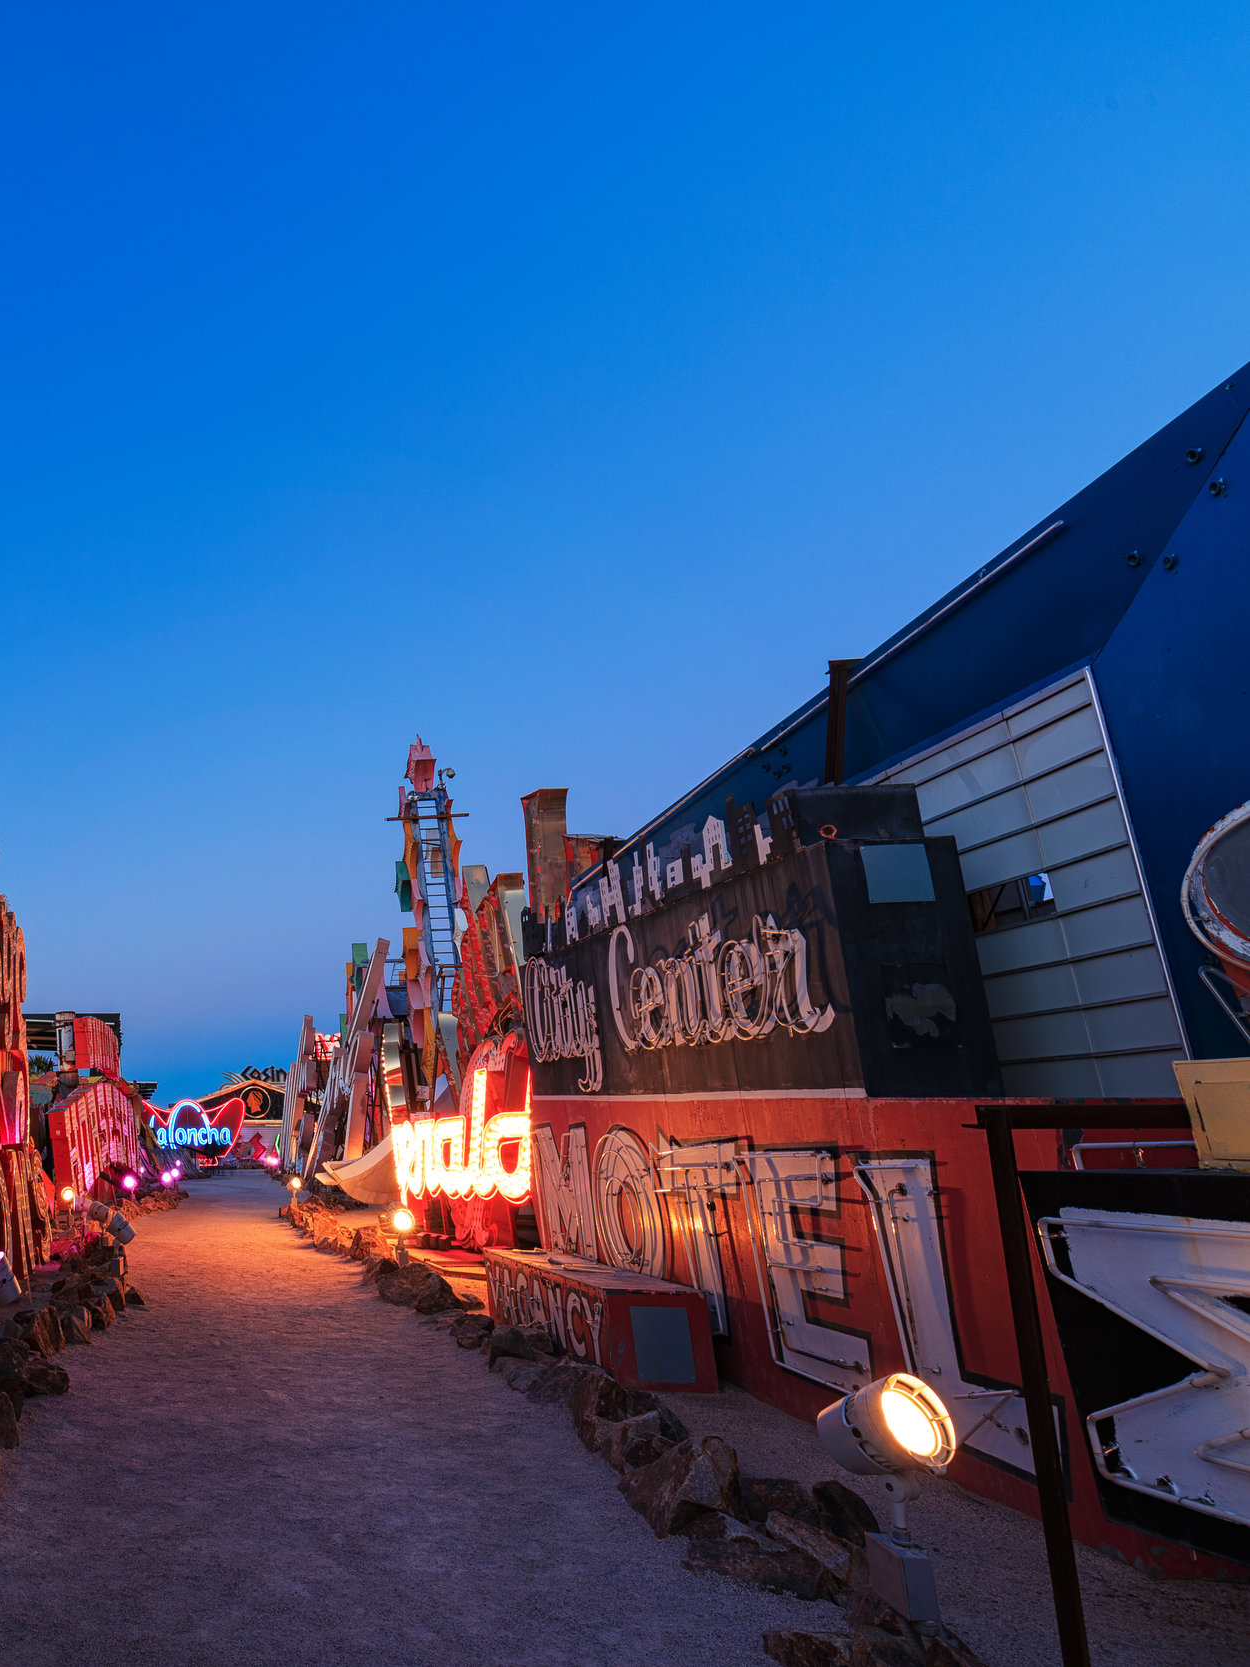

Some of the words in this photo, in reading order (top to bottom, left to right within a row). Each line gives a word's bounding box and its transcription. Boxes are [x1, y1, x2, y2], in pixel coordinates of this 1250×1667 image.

[525, 956, 603, 1093] City
[608, 912, 836, 1051] Center
[486, 1258, 604, 1367] VACANCY
[532, 1124, 1069, 1492] MOTEL
